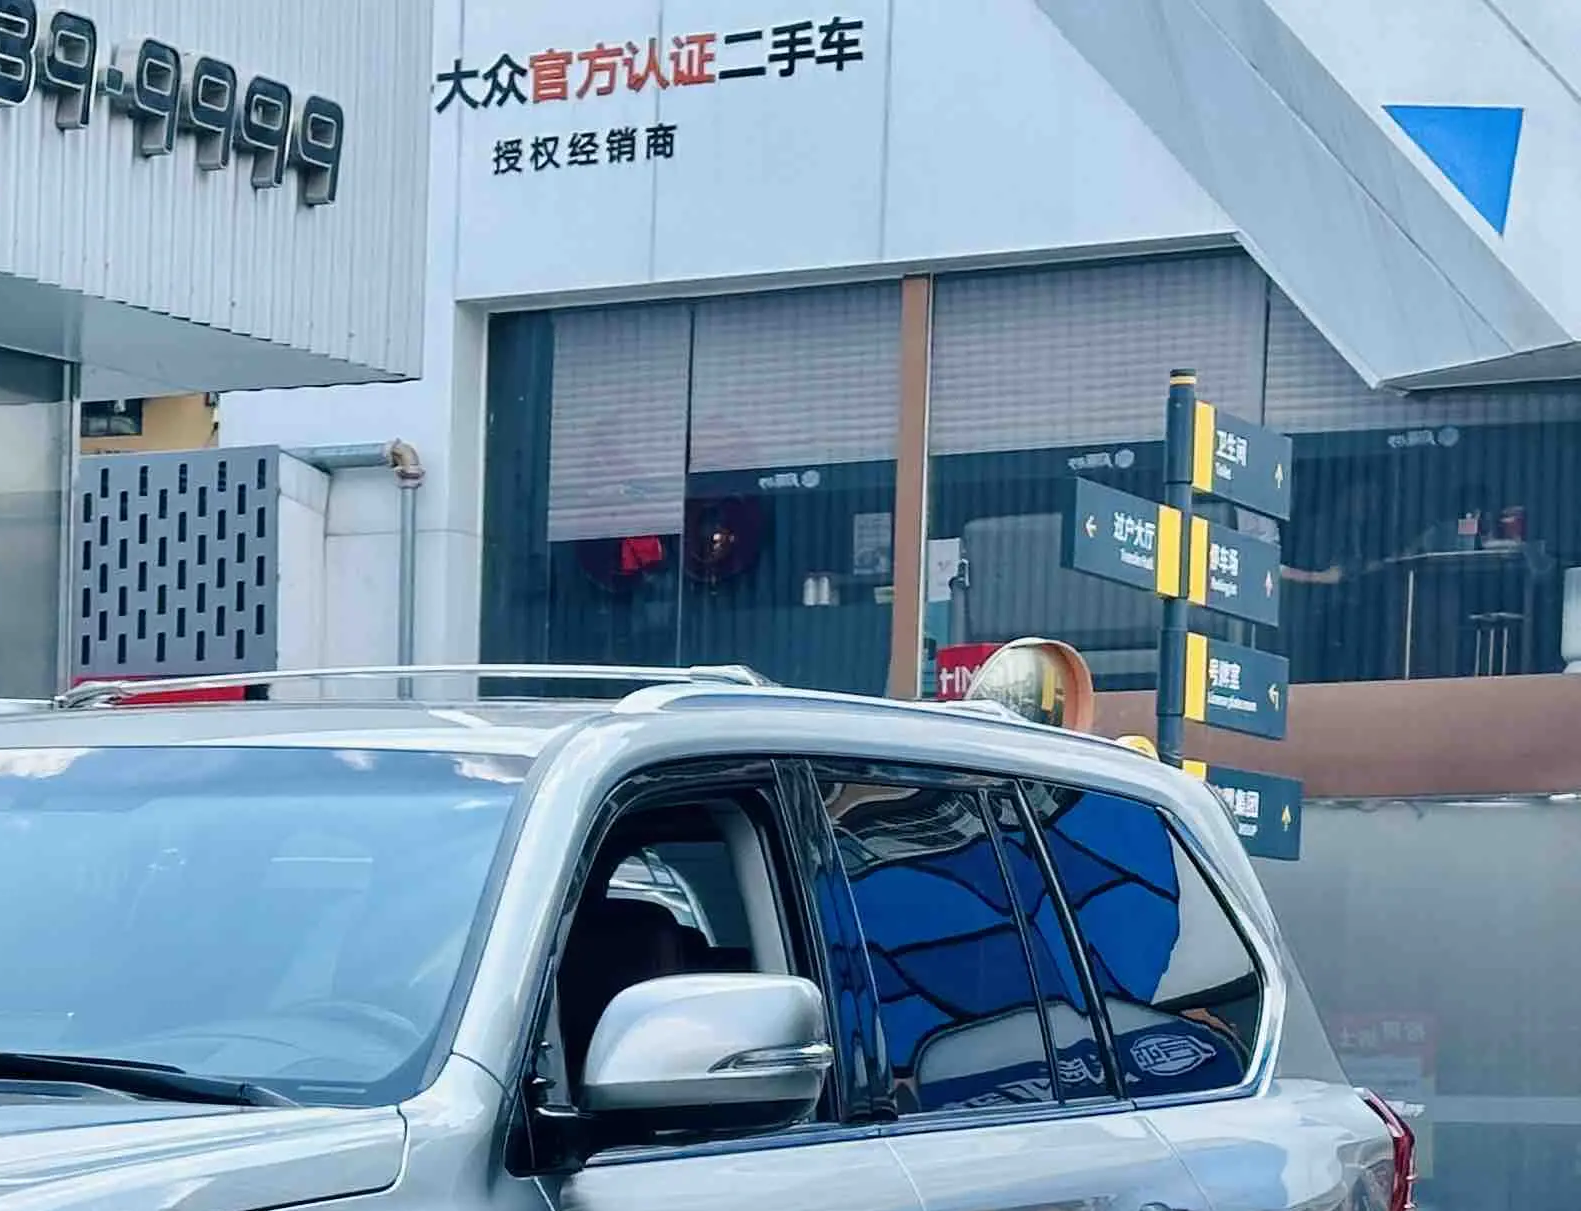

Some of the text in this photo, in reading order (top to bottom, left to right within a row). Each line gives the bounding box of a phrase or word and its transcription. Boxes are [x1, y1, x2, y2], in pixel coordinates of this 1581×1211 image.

[435, 17, 864, 113] 大众官方认证二手车
[492, 123, 678, 175] 授权经销商
